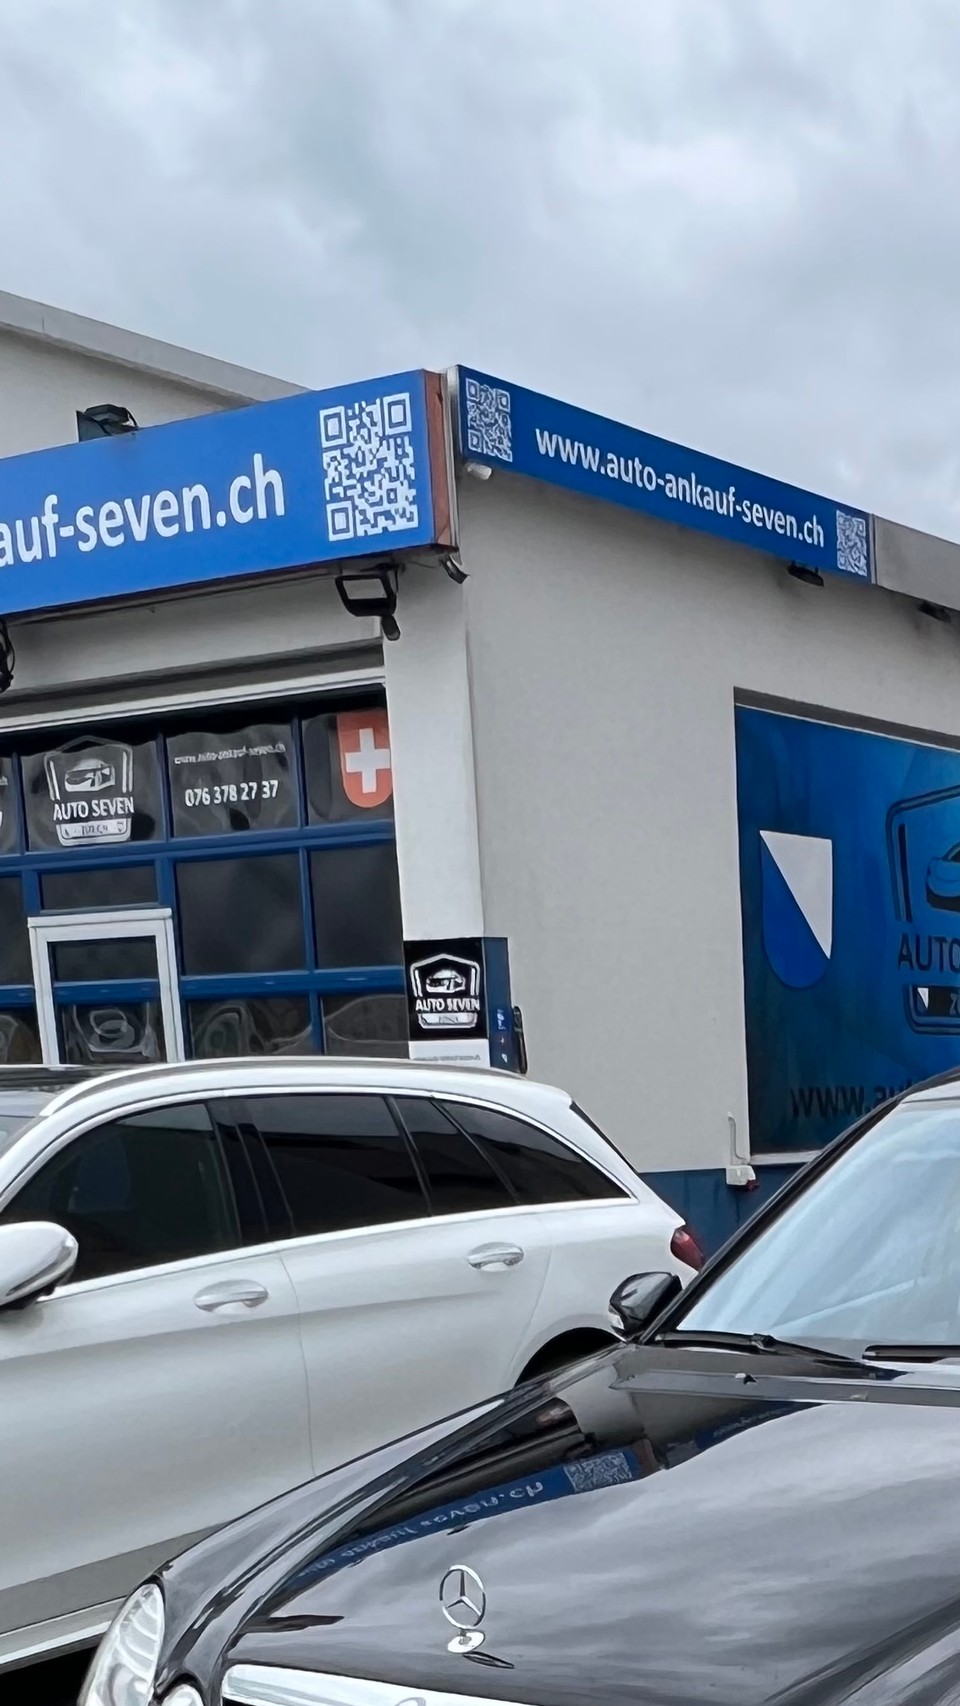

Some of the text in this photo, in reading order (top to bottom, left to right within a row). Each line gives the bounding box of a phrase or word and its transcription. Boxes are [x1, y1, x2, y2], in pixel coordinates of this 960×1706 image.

[535, 428, 825, 548] www.auto-ankauf-seven.ch
[185, 780, 278, 806] 076 378 27 37
[53, 796, 135, 820] AUTO SEVEN
[415, 998, 480, 1011] AUTO SEVEN
